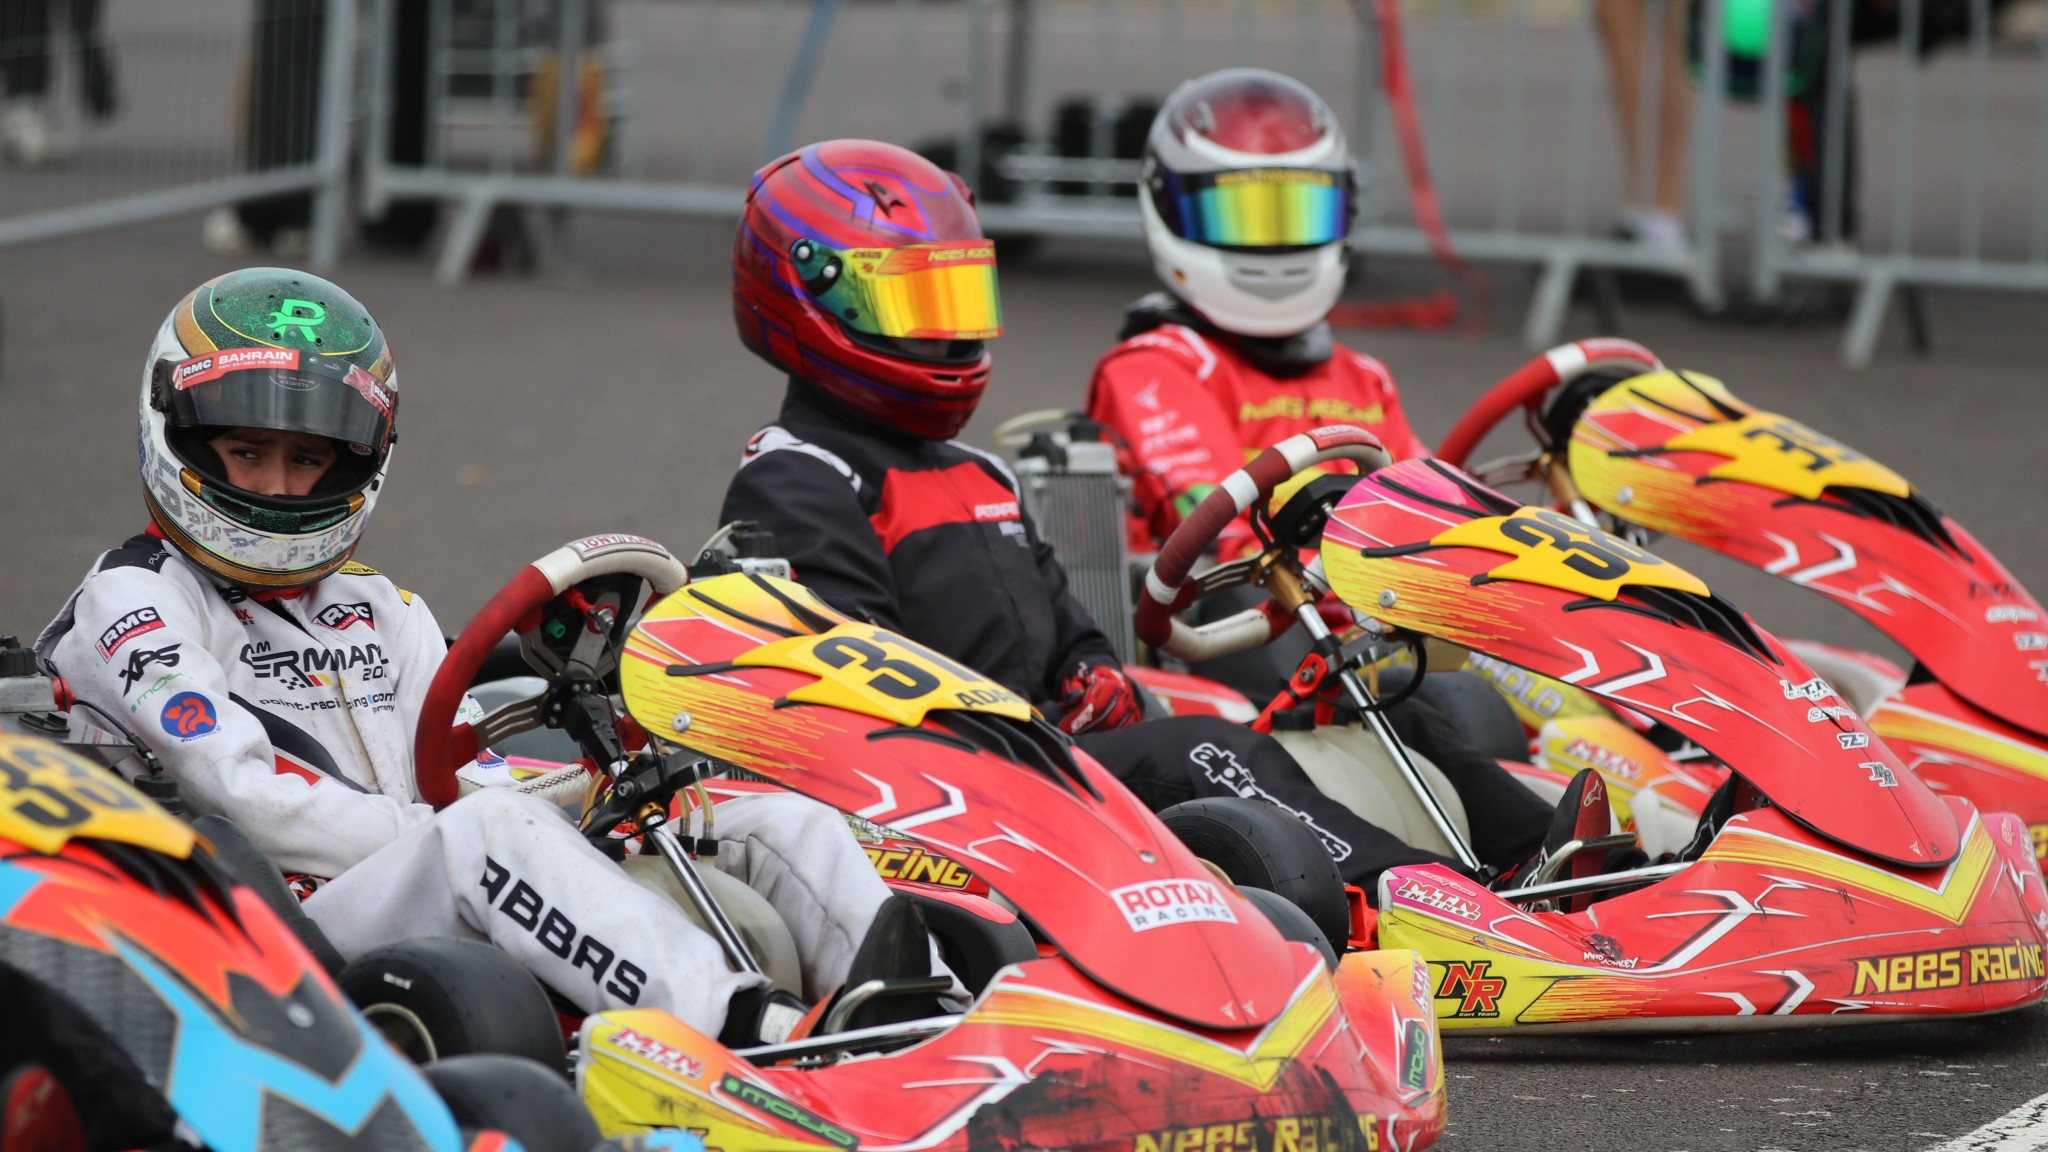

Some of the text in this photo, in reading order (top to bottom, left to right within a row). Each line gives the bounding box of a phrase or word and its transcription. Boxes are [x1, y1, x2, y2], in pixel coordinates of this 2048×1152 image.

[183, 359, 212, 377] RMC
[219, 351, 293, 364] BAHRAIN
[1499, 510, 1664, 581] 38
[101, 609, 158, 648] RMC
[812, 630, 984, 700] 31
[1120, 882, 1224, 914] ROTAX
[1132, 906, 1232, 926] RACING
